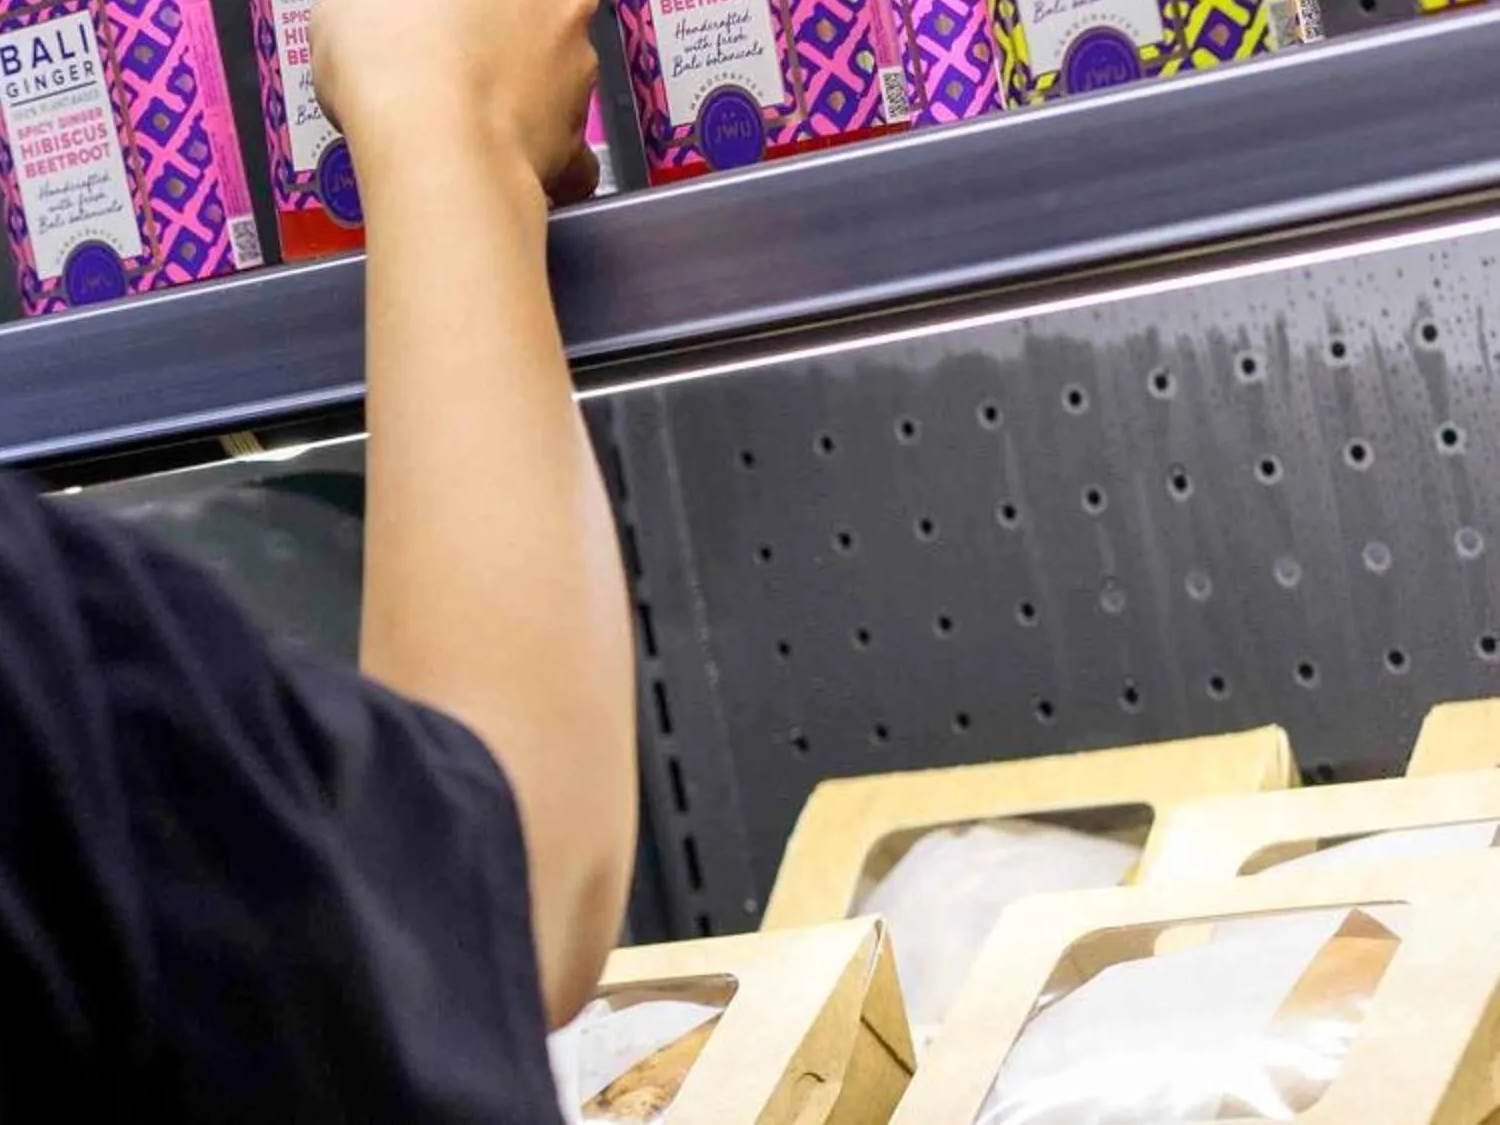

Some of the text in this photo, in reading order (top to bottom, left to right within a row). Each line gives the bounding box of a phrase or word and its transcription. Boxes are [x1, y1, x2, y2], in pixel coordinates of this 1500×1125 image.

[282, 9, 311, 25] SPIC
[675, 8, 751, 40] Handcrafted
[0, 23, 89, 76] BALI
[672, 54, 701, 77] Bali
[6, 60, 95, 98] GINGER
[20, 122, 108, 160] HIBISCUS
[25, 142, 111, 179] BEETROOT
